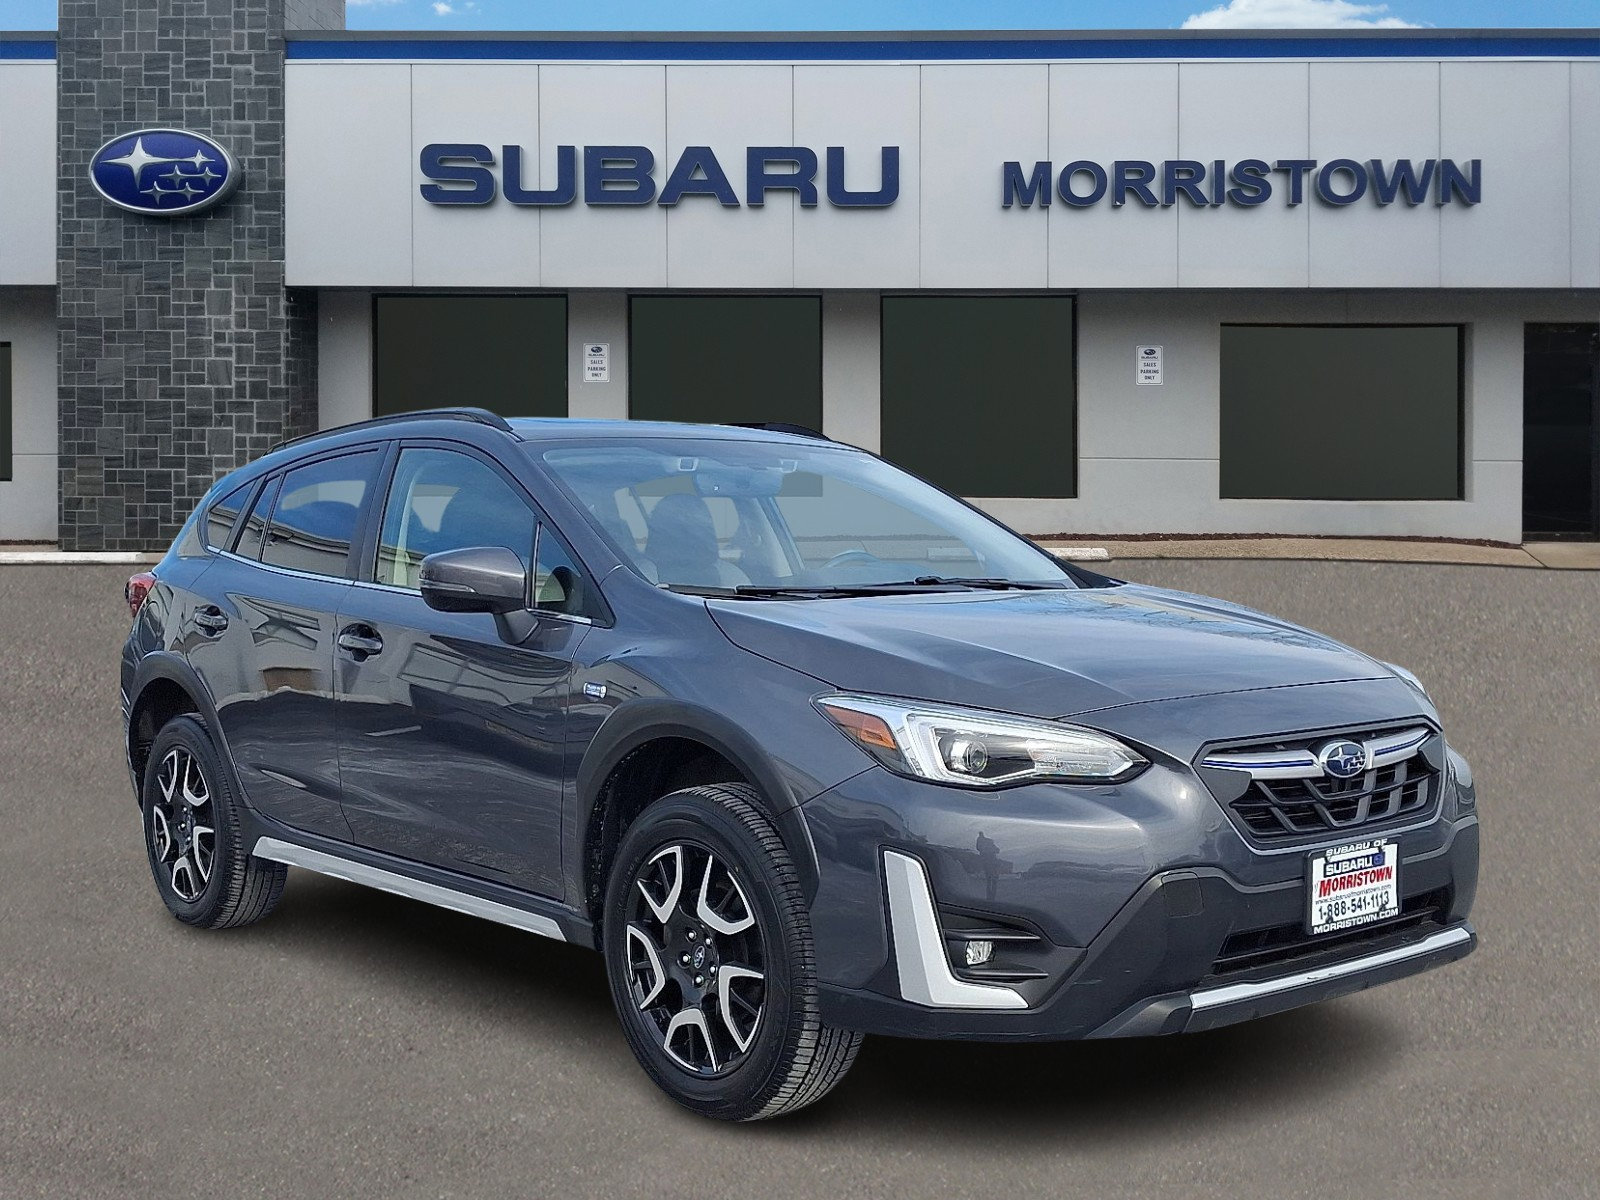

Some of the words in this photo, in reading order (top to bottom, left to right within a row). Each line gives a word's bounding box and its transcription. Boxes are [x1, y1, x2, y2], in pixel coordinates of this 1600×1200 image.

[420, 143, 900, 207] SUBARU
[1002, 159, 1482, 208] MORRISTOWN
[1325, 841, 1370, 857] SUBARU
[1373, 838, 1388, 847] OF
[1325, 856, 1373, 876] SUBARU
[1318, 865, 1393, 898] MORRISTOWN
[1313, 908, 1399, 935] MORRISTOWN.COM
